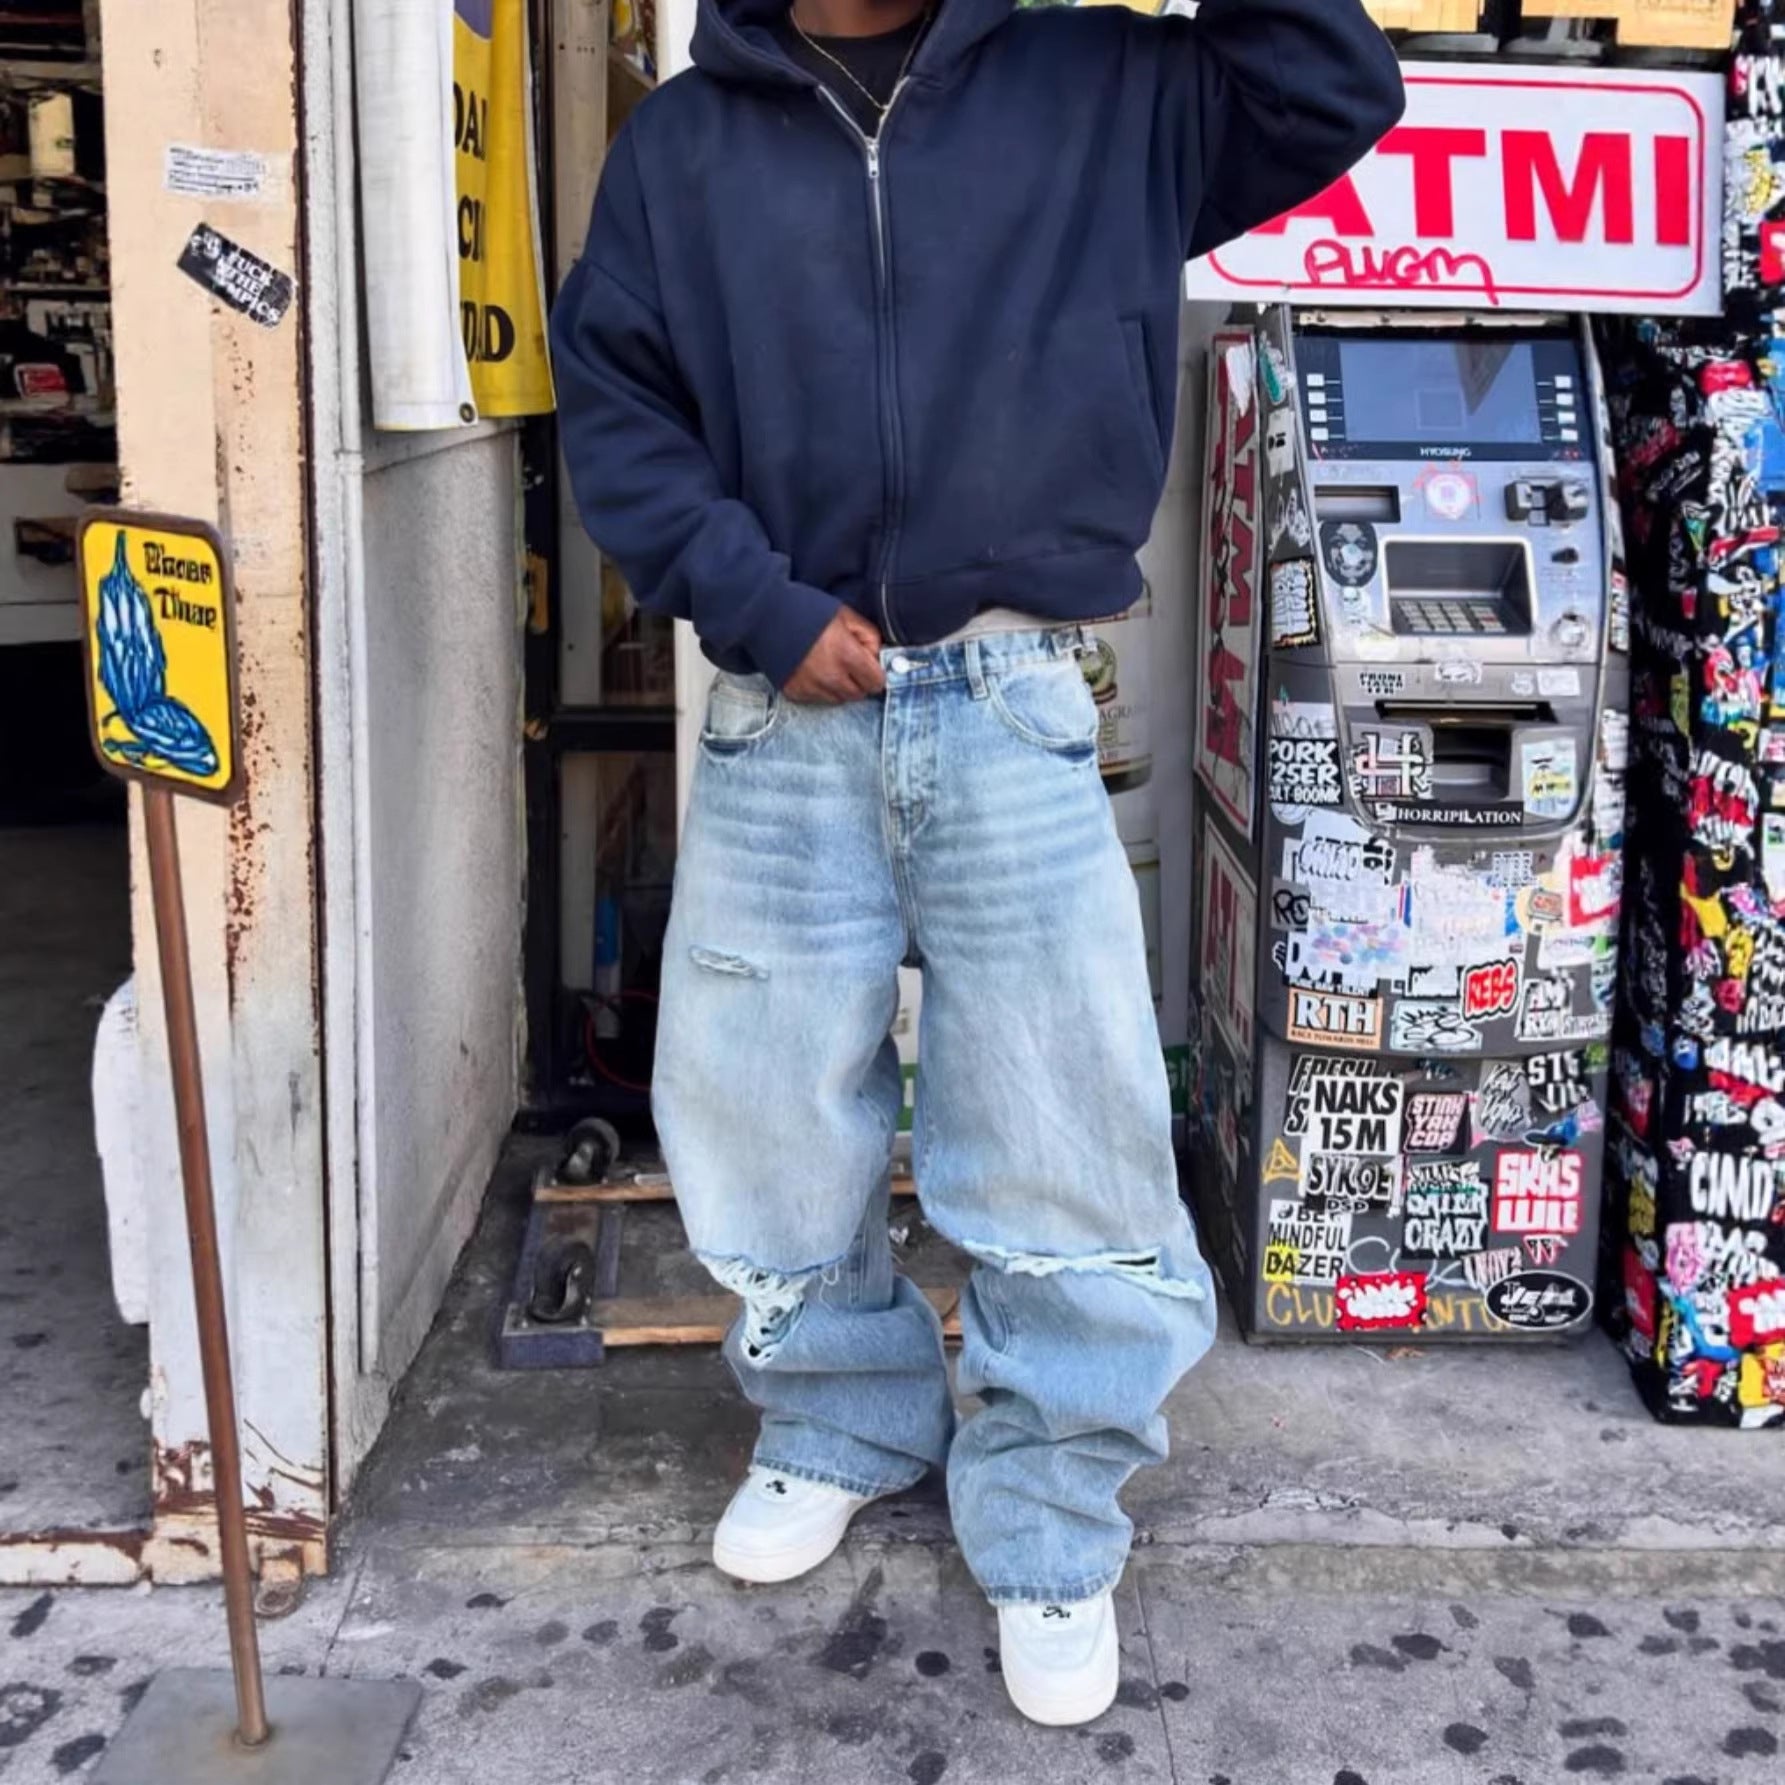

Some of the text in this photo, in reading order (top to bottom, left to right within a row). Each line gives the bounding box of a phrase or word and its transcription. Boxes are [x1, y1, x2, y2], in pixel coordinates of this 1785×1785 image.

[1399, 807, 1523, 825] HORRIPILATION
[1294, 992, 1376, 1035] RTH
[1314, 1080, 1400, 1116] NAKS
[1268, 1222, 1347, 1253] MINDFUL
[1404, 1217, 1488, 1258] CRAZY
[1265, 1251, 1344, 1280] DAZER
